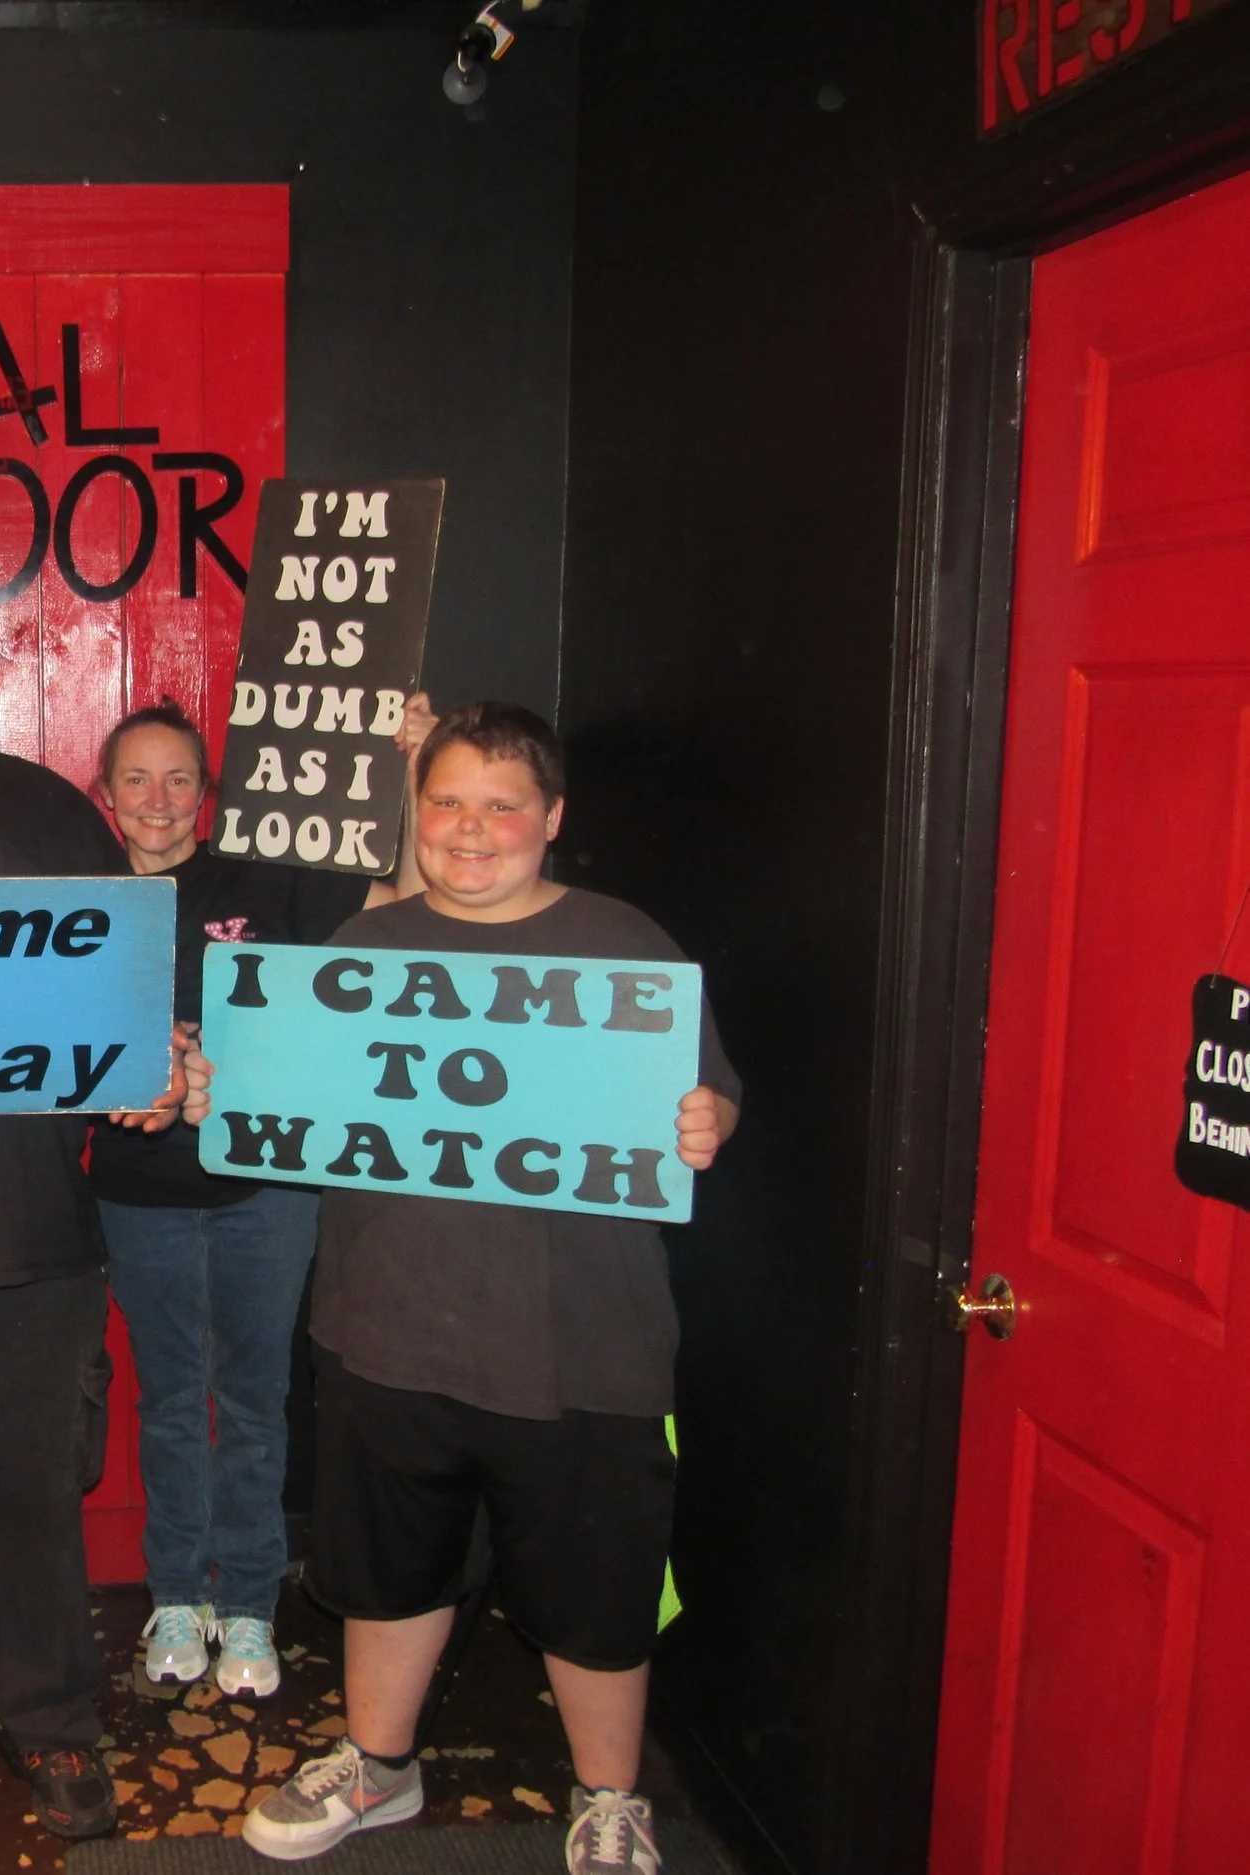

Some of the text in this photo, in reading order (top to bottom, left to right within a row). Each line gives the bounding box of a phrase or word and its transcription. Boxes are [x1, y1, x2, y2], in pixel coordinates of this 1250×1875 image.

[293, 491, 390, 538] I'M
[275, 556, 396, 604] NOT
[284, 620, 365, 668] AS
[228, 681, 406, 737] DUMB
[245, 746, 373, 801] AS I
[218, 808, 381, 869] LOOK
[226, 953, 674, 1033] I CAME
[366, 1041, 509, 1107] TO
[220, 1111, 670, 1209] WATCH
